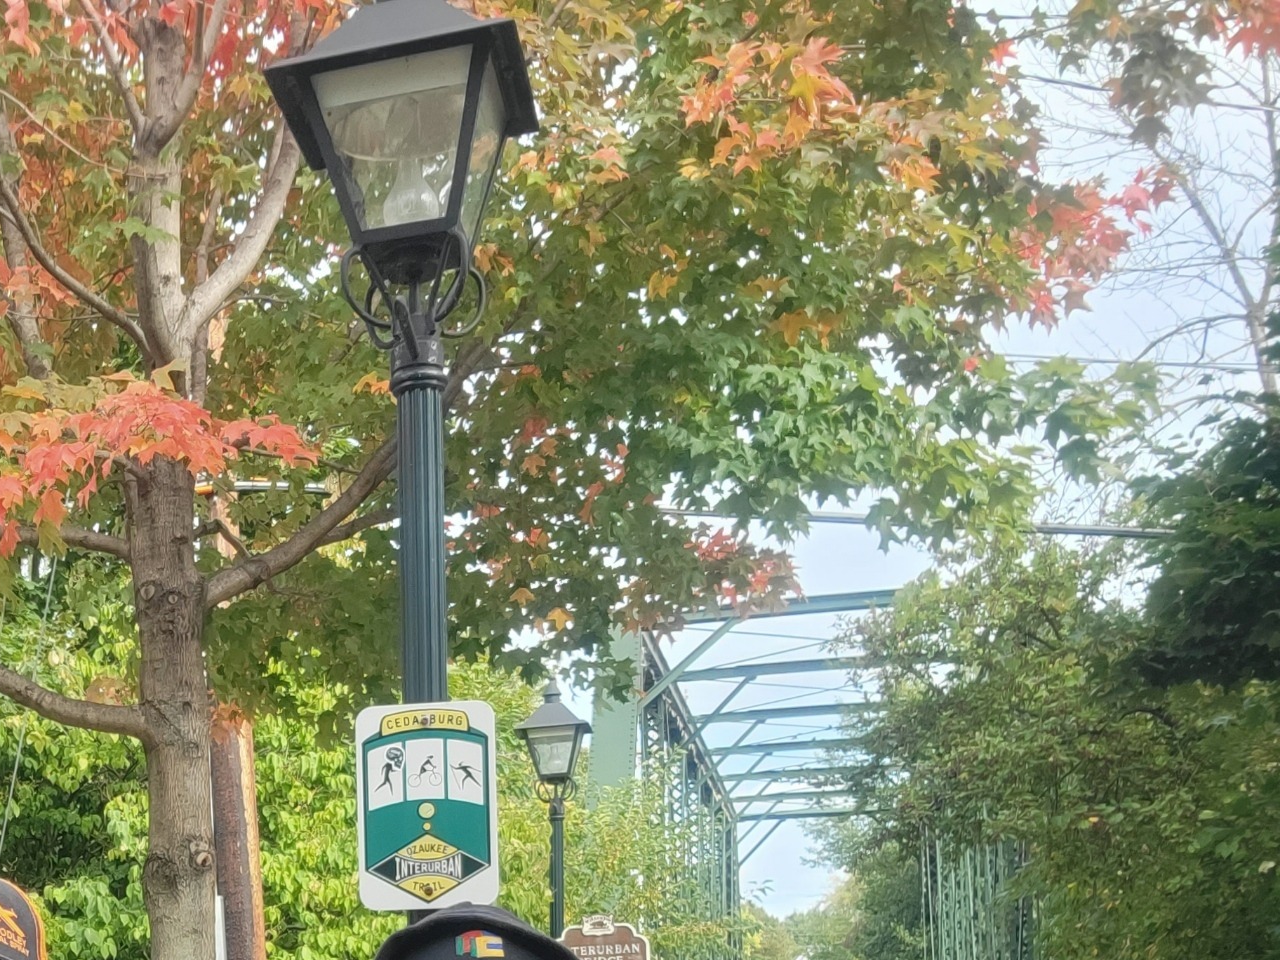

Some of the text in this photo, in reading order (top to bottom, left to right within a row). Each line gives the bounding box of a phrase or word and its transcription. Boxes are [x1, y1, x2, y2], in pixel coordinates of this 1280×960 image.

[386, 713, 464, 730] CEDABURG
[406, 843, 450, 856] OZAUKEE
[395, 852, 463, 881] INTERURBAN
[571, 943, 640, 956] TERURBAN
